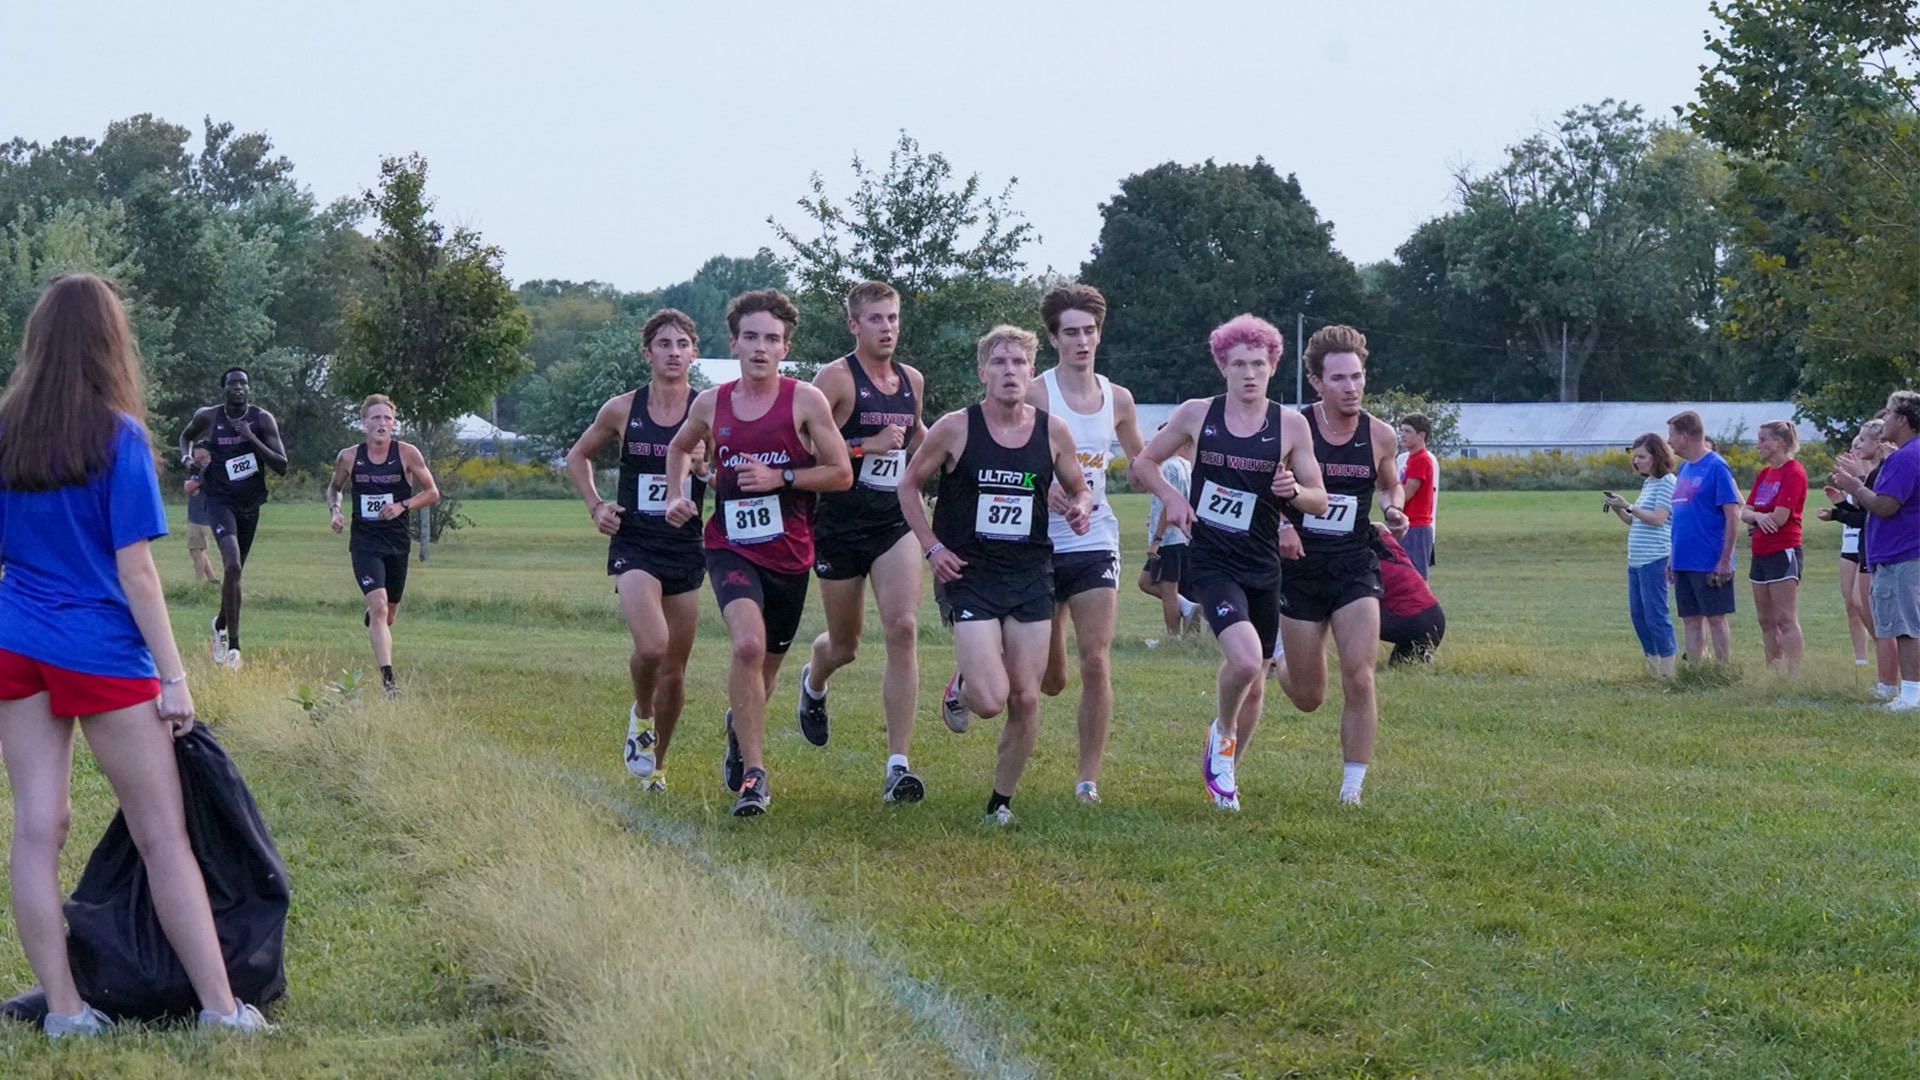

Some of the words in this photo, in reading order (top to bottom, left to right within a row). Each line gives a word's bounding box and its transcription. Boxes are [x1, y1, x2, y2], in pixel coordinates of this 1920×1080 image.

[860, 412, 882, 425] RED
[627, 442, 650, 455] RED
[232, 459, 252, 474] 282
[871, 458, 899, 477] 271
[1200, 450, 1224, 466] RED
[1226, 454, 1276, 473] WOLVES
[1326, 463, 1370, 478] WOLVES
[648, 484, 668, 501] 27
[988, 504, 1022, 525] 372
[1208, 494, 1243, 518] 274
[735, 507, 771, 529] 318
